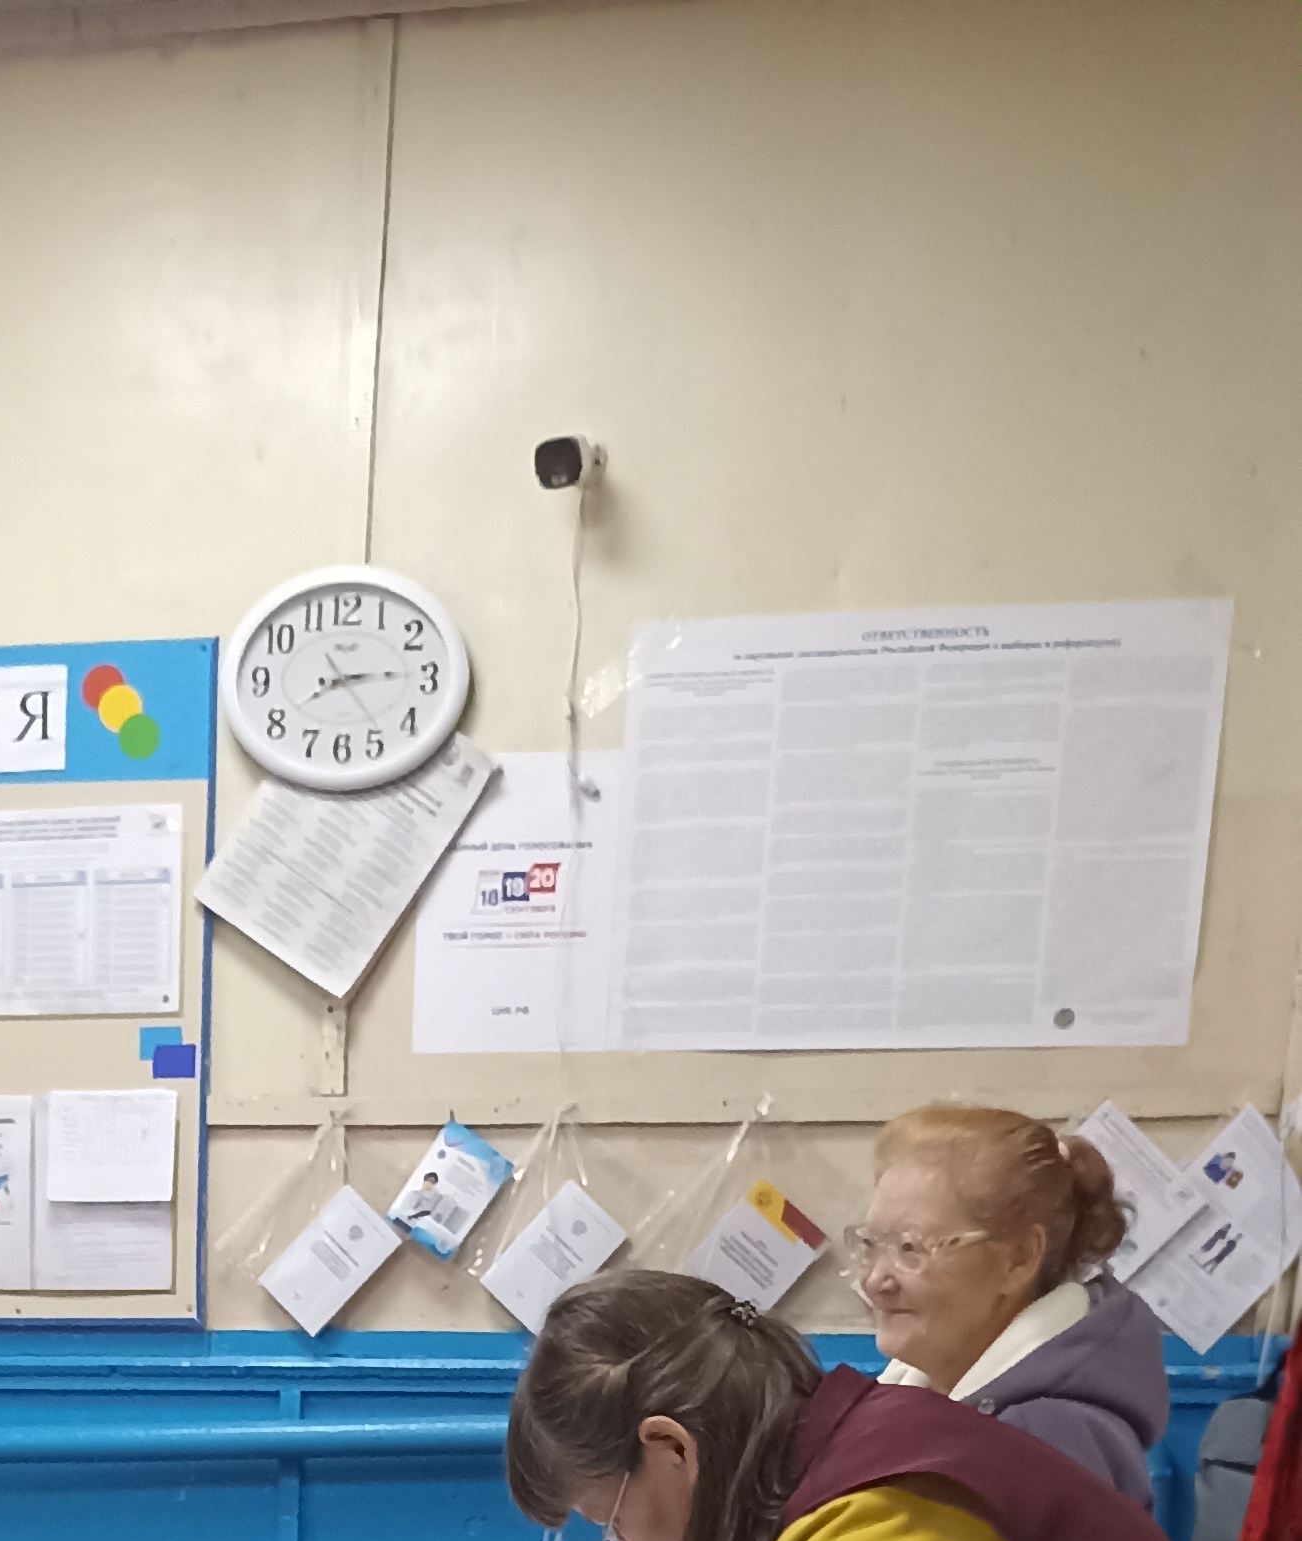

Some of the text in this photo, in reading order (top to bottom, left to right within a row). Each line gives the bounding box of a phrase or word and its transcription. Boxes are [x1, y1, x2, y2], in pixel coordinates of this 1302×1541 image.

[304, 600, 324, 632] 11
[332, 591, 362, 626] 12
[377, 599, 386, 631] 1
[266, 623, 295, 655] 10
[403, 619, 424, 651] 2
[251, 666, 271, 698] 9
[419, 661, 439, 695] 3
[266, 708, 287, 741] 8
[399, 706, 418, 737] 4
[302, 728, 321, 759] 7
[332, 732, 352, 765] 6
[364, 728, 385, 761] 5
[528, 868, 556, 889] 20
